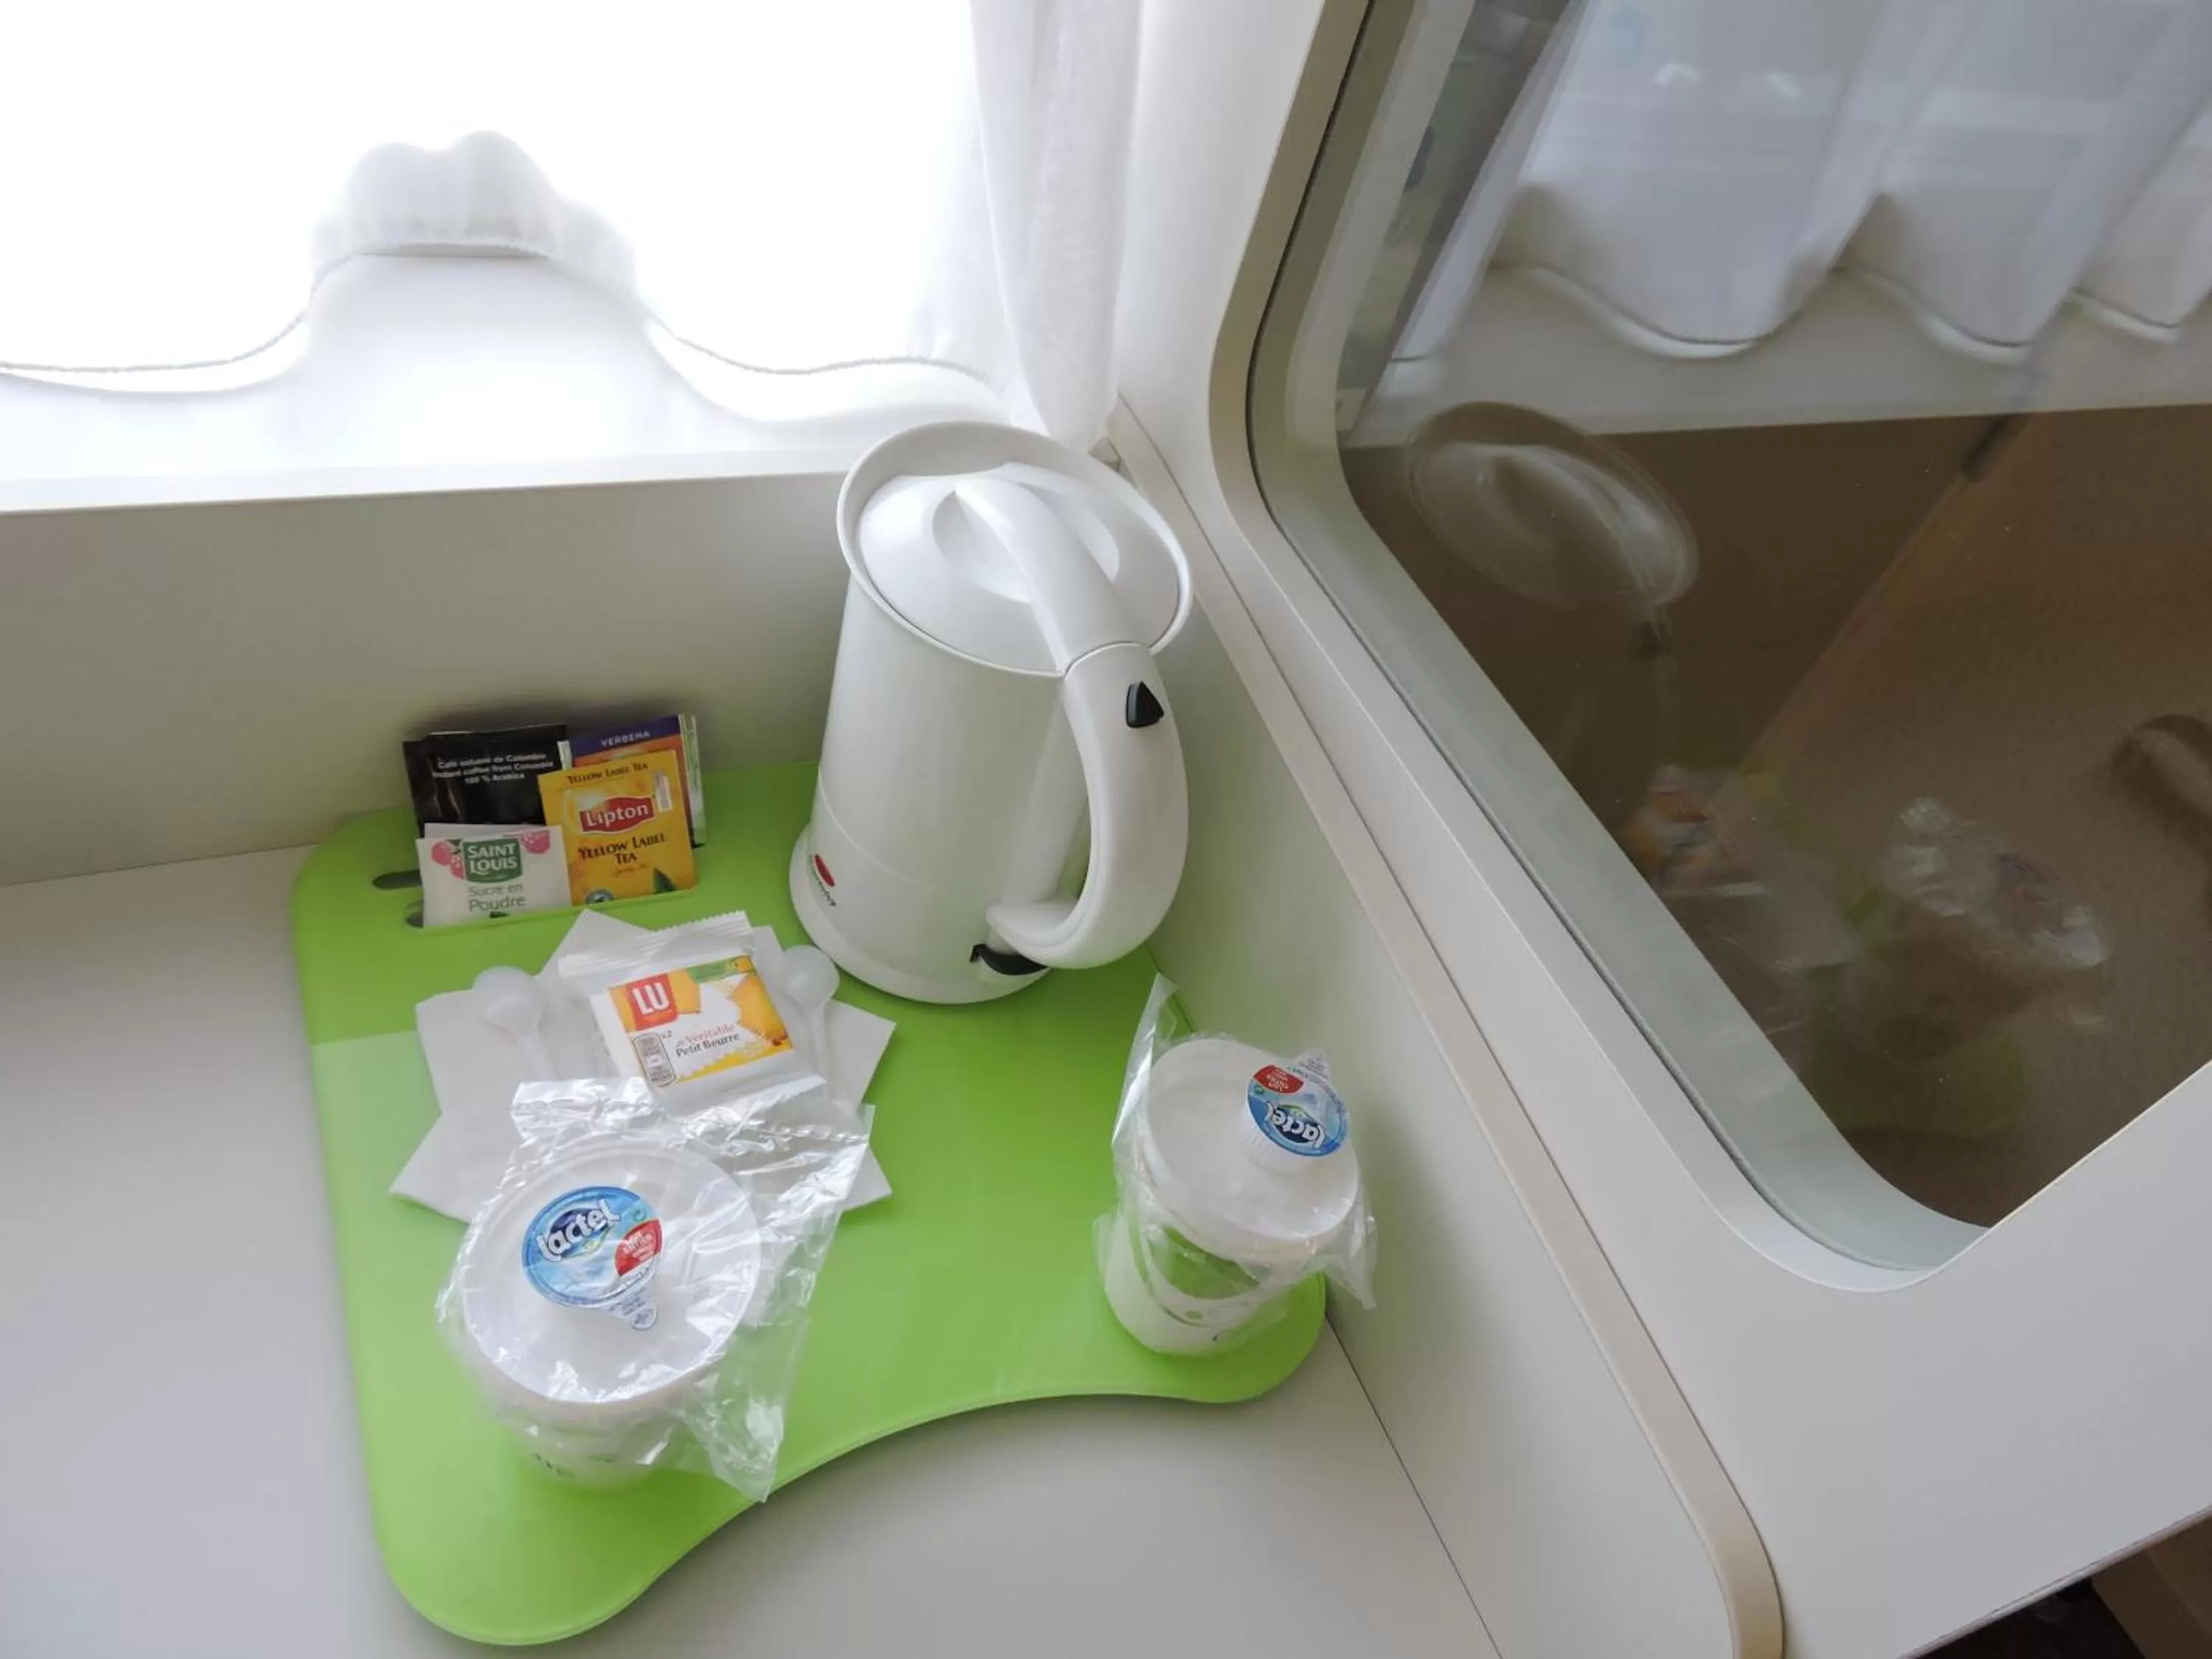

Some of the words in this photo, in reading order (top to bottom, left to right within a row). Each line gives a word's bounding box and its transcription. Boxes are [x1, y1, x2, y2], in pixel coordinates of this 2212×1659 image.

[601, 729, 650, 747] VERBENA
[585, 804, 650, 827] Lipton
[467, 843, 517, 859] SAINT
[577, 841, 628, 860] YELLOW
[631, 833, 665, 849] LABEL
[469, 856, 518, 876] LOUIS
[613, 852, 638, 865] TEA
[468, 894, 526, 912] Poudre
[631, 981, 670, 1015] LU
[675, 1043, 702, 1058] Petit
[702, 1033, 740, 1050] Beurre
[1263, 1100, 1326, 1149] lactel
[535, 1198, 622, 1262] lactel
